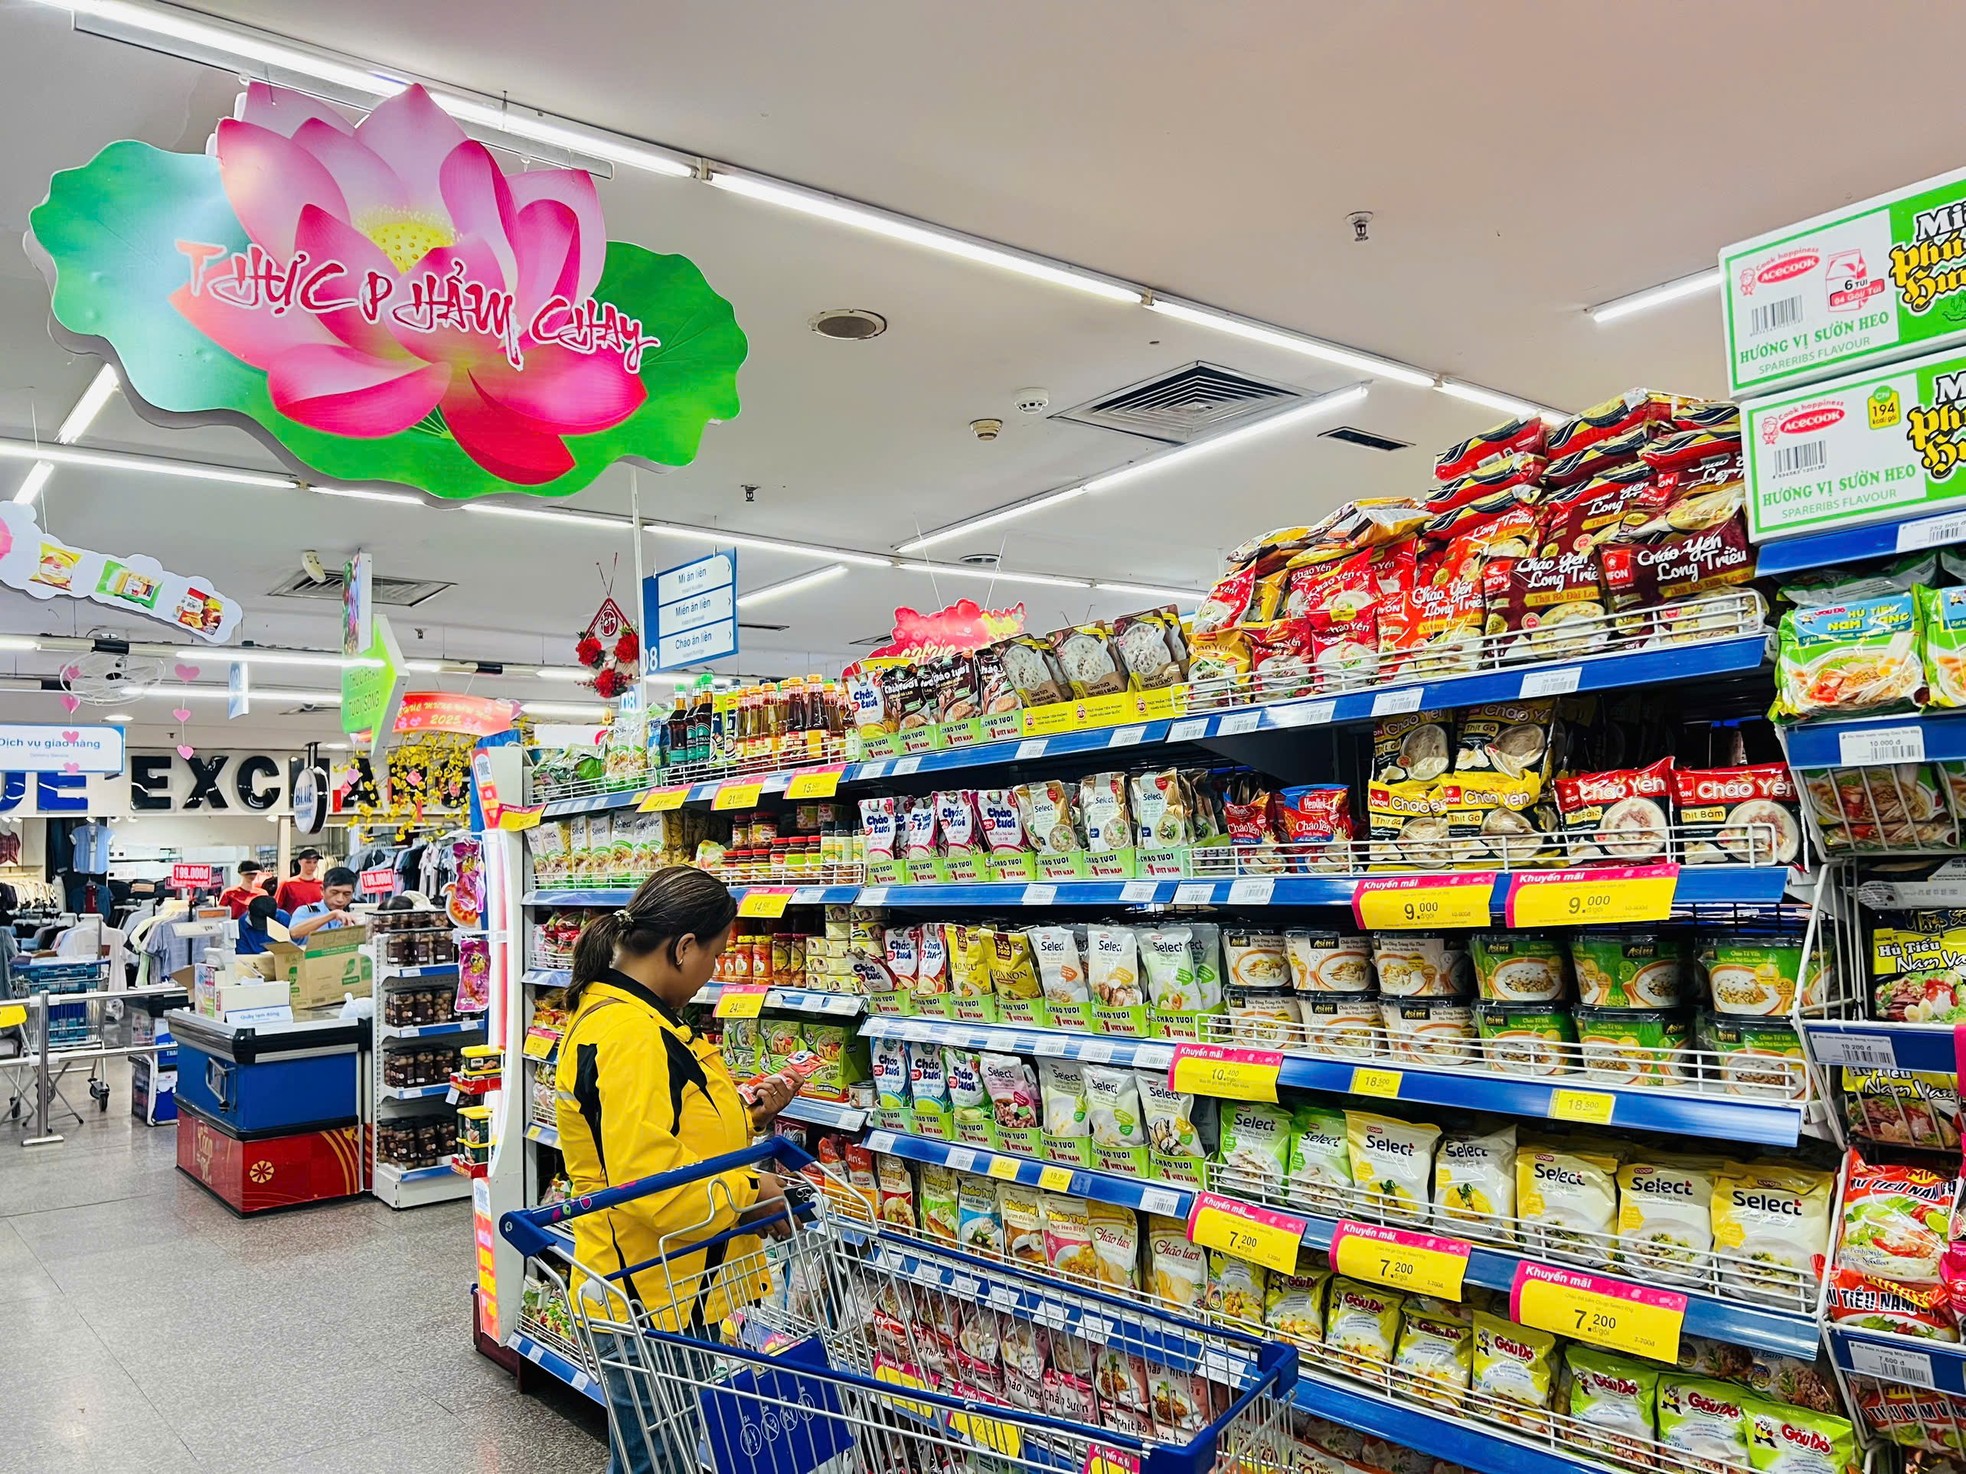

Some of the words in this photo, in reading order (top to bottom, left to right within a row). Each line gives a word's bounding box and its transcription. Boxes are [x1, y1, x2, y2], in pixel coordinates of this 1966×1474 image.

[1844, 279, 1852, 291] 6
[177, 243, 357, 316] THỰC
[531, 297, 660, 373] CHAY
[1740, 339, 1788, 364] HƯƠNG
[1793, 333, 1809, 349] VỊ
[1814, 314, 1854, 340] SƯỜN
[1859, 312, 1889, 330] HEO
[1759, 352, 1815, 374] SPARERIBS
[1818, 337, 1871, 359] FLAVOUR
[1872, 402, 1895, 417] 194
[1763, 484, 1812, 507] HƯƠNG
[1817, 480, 1833, 497] VỊ
[1839, 466, 1880, 492] SƯỜN
[1884, 464, 1916, 483] HEO
[1782, 500, 1840, 519] SPARERIBS
[1842, 489, 1897, 507] FLAVOUR
[1528, 570, 1565, 592] Long
[1657, 562, 1699, 583] Long
[1034, 804, 1054, 813] Select
[1143, 802, 1163, 811] Select
[1363, 881, 1397, 891] Khuyến
[1520, 871, 1562, 884] Khuyến
[1563, 871, 1585, 881] mãi
[1879, 941, 1902, 957] Hủ
[1905, 938, 1940, 954] Tiếu
[1896, 955, 1939, 973] Nam
[1180, 1046, 1207, 1058] Khuyến
[1149, 1086, 1182, 1101] Select
[1233, 1113, 1276, 1133] Select
[1300, 1130, 1341, 1147] Select
[1365, 1134, 1415, 1157] Select
[1445, 1142, 1489, 1159] Select
[1534, 1162, 1586, 1186] Select
[1630, 1177, 1694, 1197] Select
[1203, 1196, 1231, 1213] Khuyến
[1732, 1189, 1803, 1217] Select
[1343, 1223, 1377, 1239] Khuyến
[1525, 1265, 1569, 1284] Khuyến
[1569, 1276, 1593, 1288] mãi
